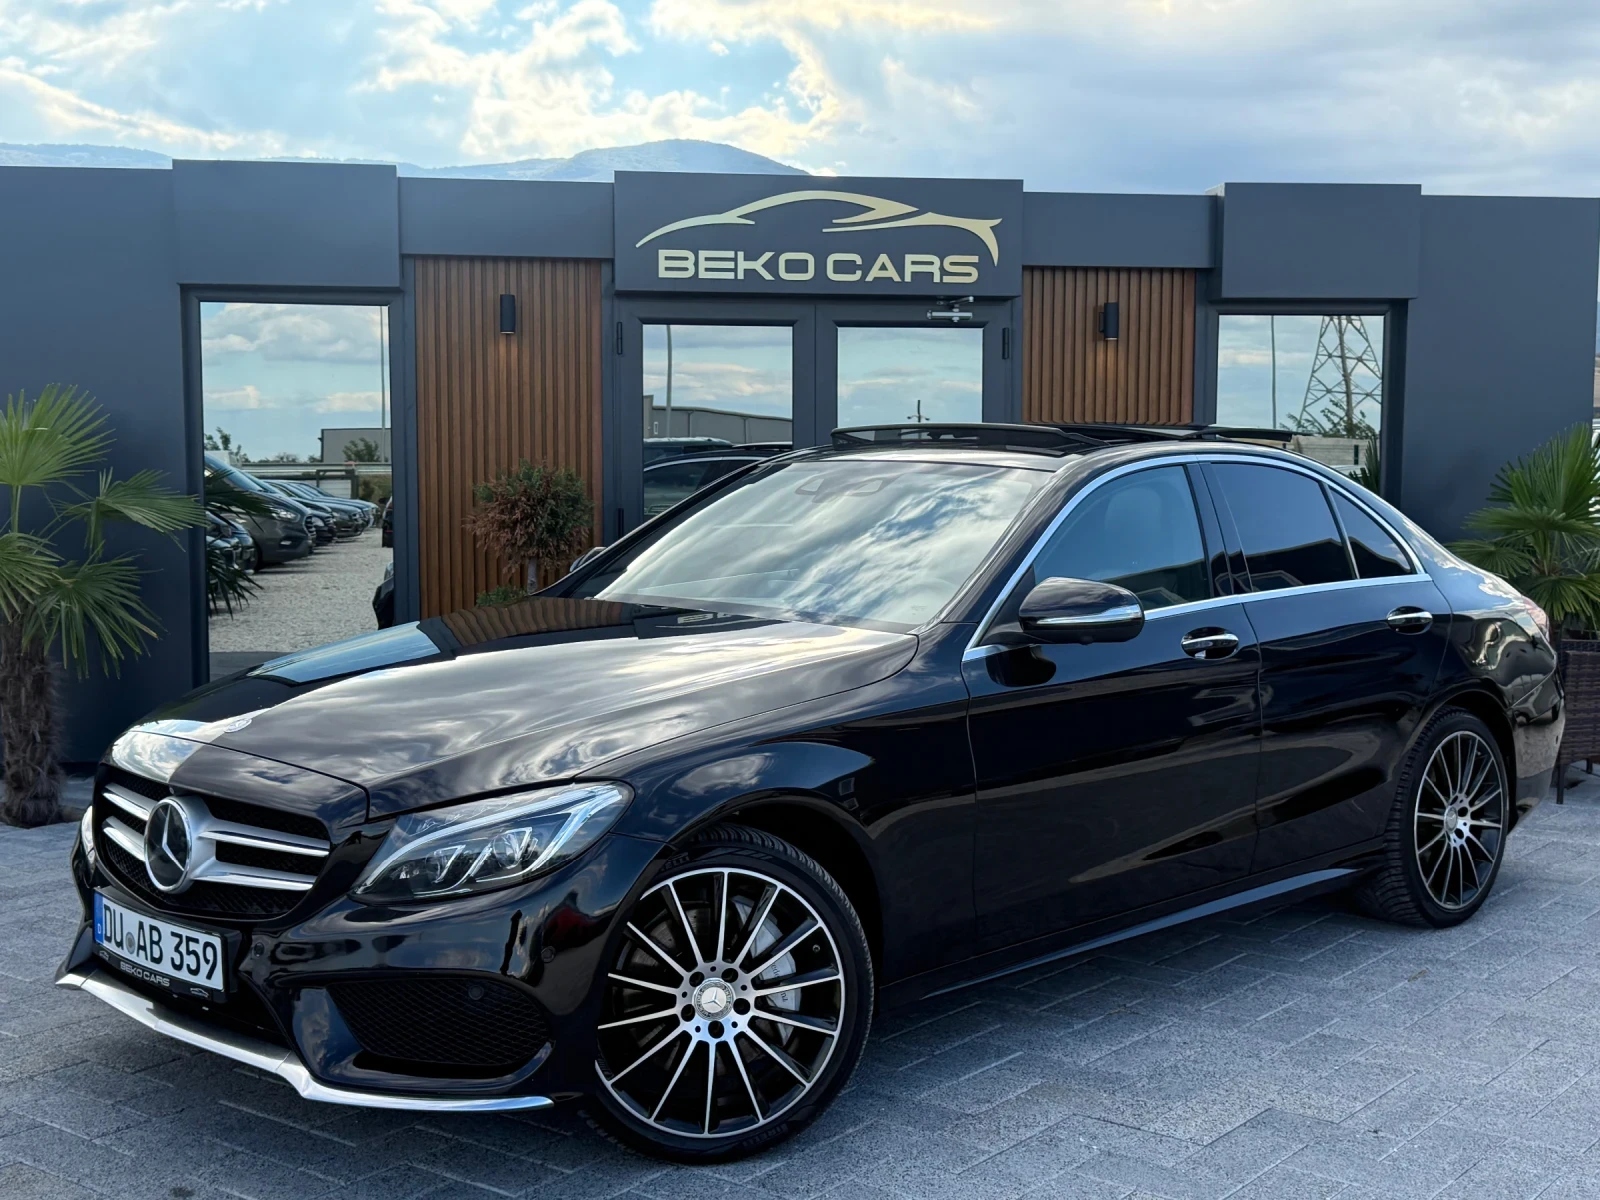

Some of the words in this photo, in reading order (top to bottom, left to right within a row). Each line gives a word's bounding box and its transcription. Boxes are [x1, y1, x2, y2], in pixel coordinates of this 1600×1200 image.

[658, 249, 815, 281] BEKO
[826, 253, 980, 284] CARS
[97, 923, 102, 935] D
[104, 903, 124, 951] DU
[136, 920, 164, 965] AB
[170, 930, 218, 981] 359
[120, 961, 143, 978] BEKO
[143, 971, 171, 987] CARS
